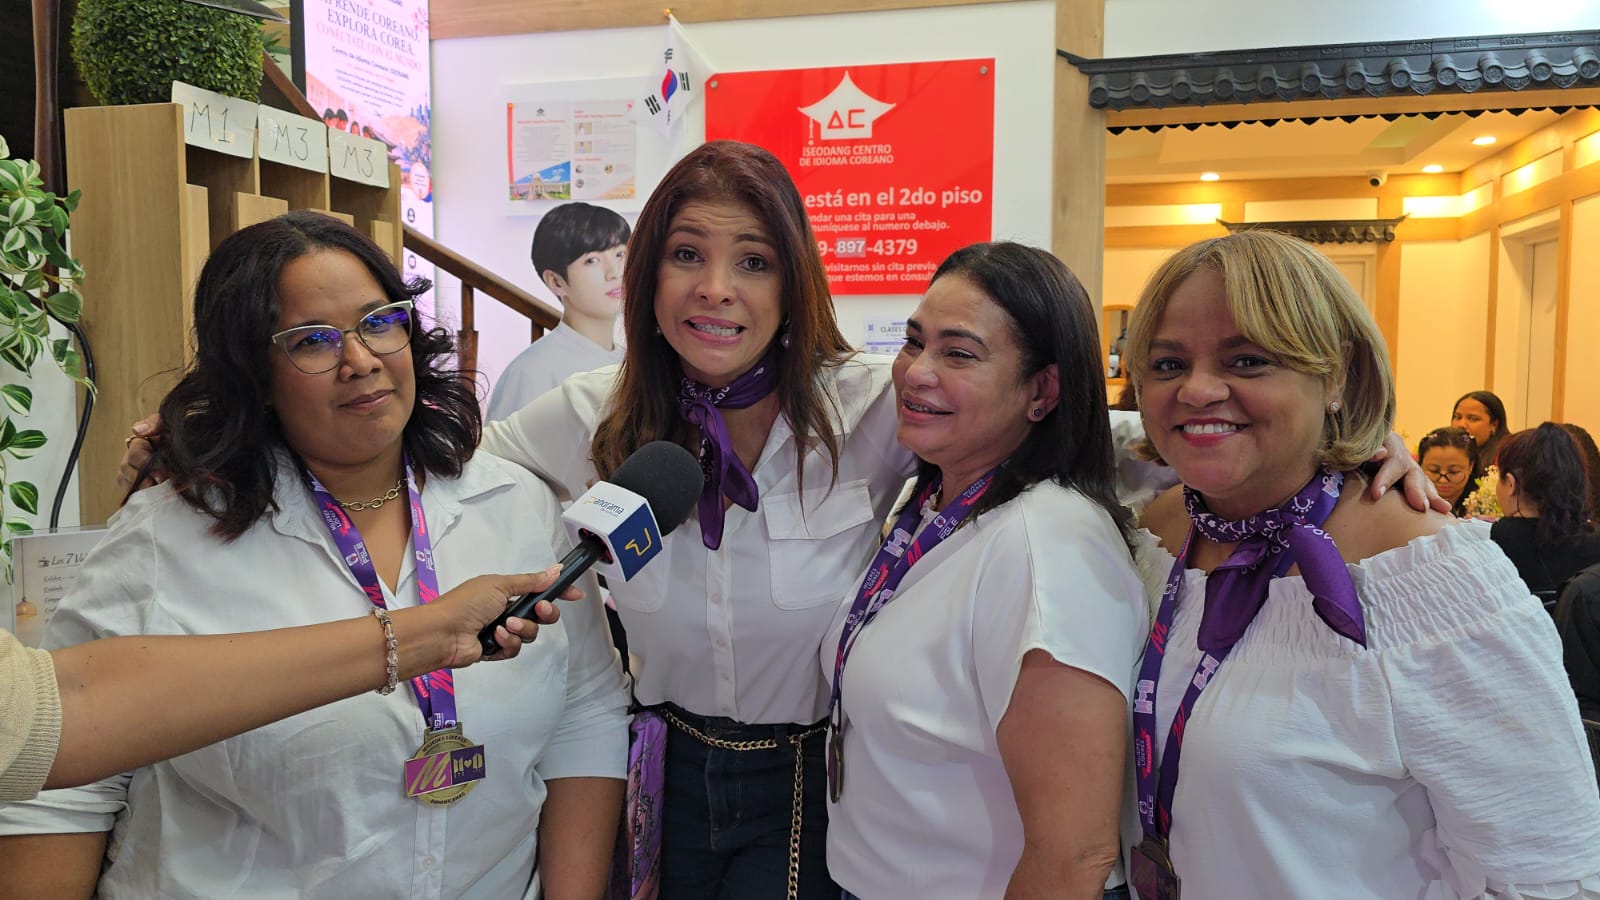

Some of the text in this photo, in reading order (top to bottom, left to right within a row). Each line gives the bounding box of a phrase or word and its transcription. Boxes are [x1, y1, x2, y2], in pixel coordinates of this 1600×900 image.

[328, 8, 377, 40] EXPLORA
[190, 101, 231, 143] M1
[274, 123, 309, 161] M3
[852, 144, 892, 155] CENTRO
[343, 144, 374, 178] M3
[799, 154, 894, 167] DE IDIOMA COREANO
[805, 186, 983, 208] está en el 2do piso
[834, 213, 852, 222] una
[854, 212, 872, 221] cita
[874, 212, 895, 224] para
[897, 212, 916, 221] una
[861, 220, 871, 231] al
[872, 262, 886, 271] sin
[888, 262, 904, 271] cita
[845, 272, 884, 282] estemos
[886, 273, 898, 281] en
